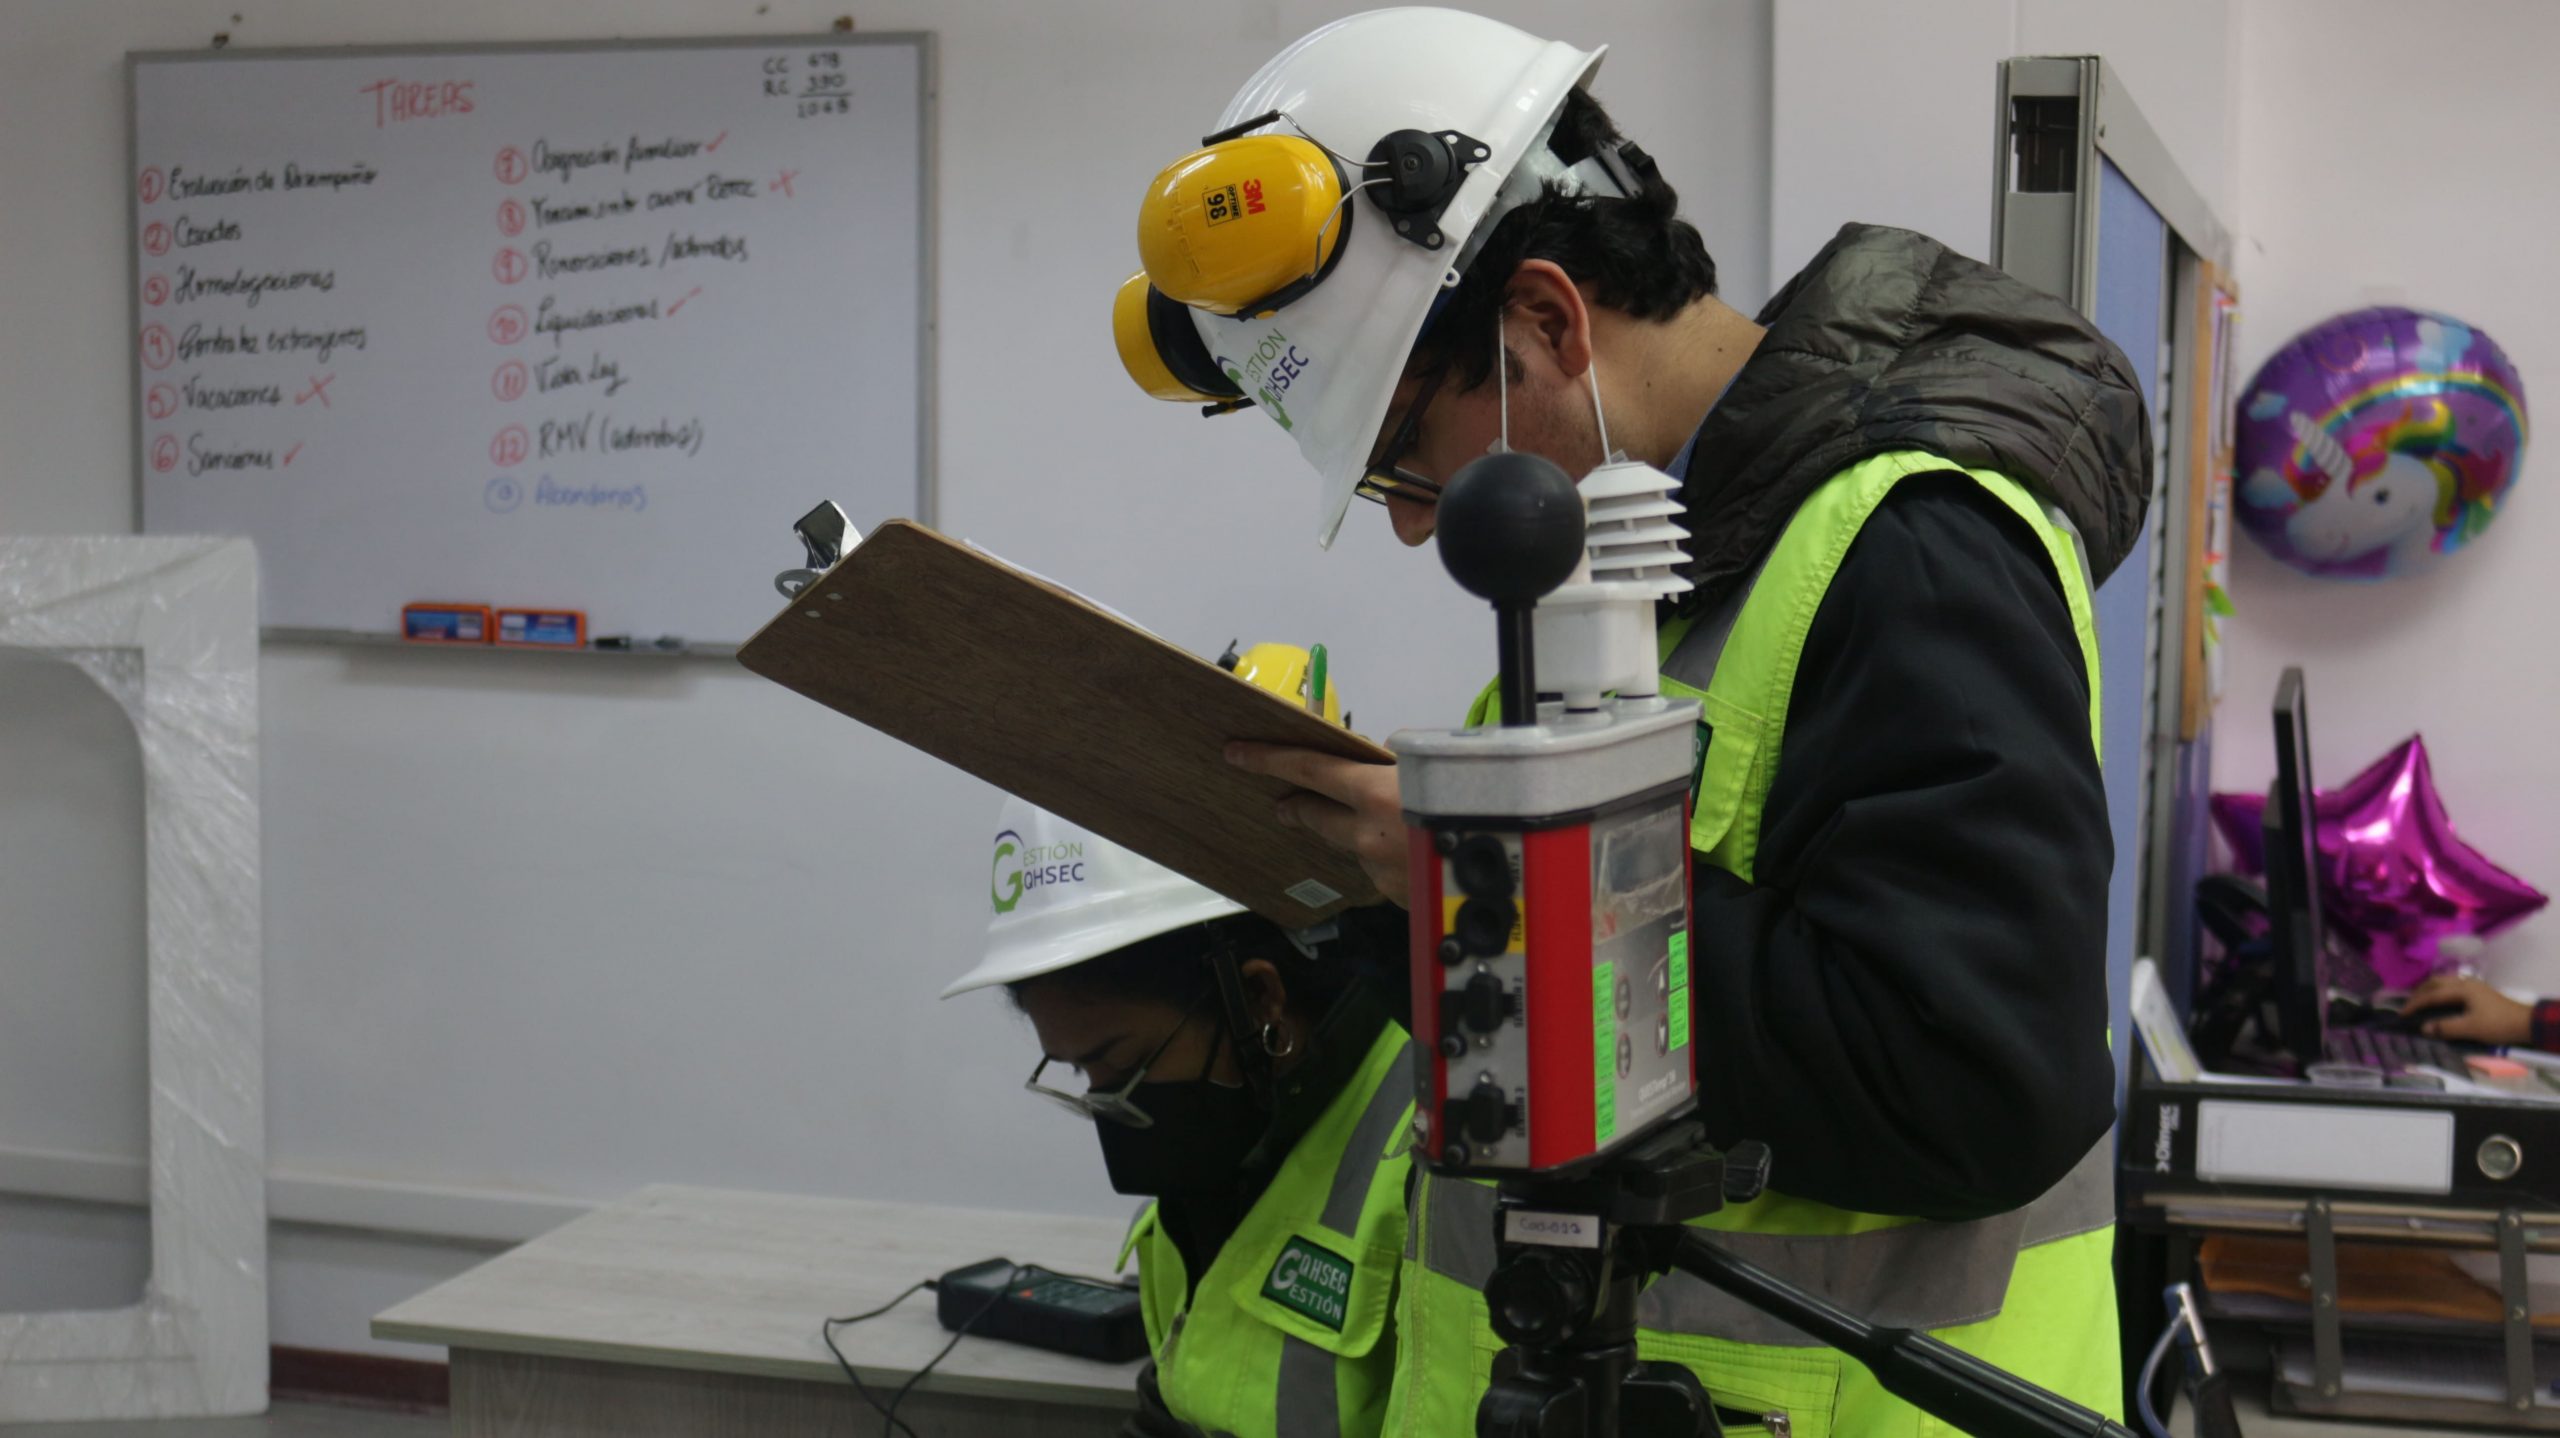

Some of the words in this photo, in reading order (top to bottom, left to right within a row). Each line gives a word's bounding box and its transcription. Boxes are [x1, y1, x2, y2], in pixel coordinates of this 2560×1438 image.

[763, 57, 789, 74] CC
[360, 79, 476, 128] TAREAS
[1207, 193, 1227, 220] 98
[1228, 186, 1240, 217] OPTIME
[1243, 178, 1266, 216] 3M
[183, 372, 283, 411] Vacaciones
[538, 411, 594, 460] RMV
[1024, 863, 1085, 890] QHSEC
